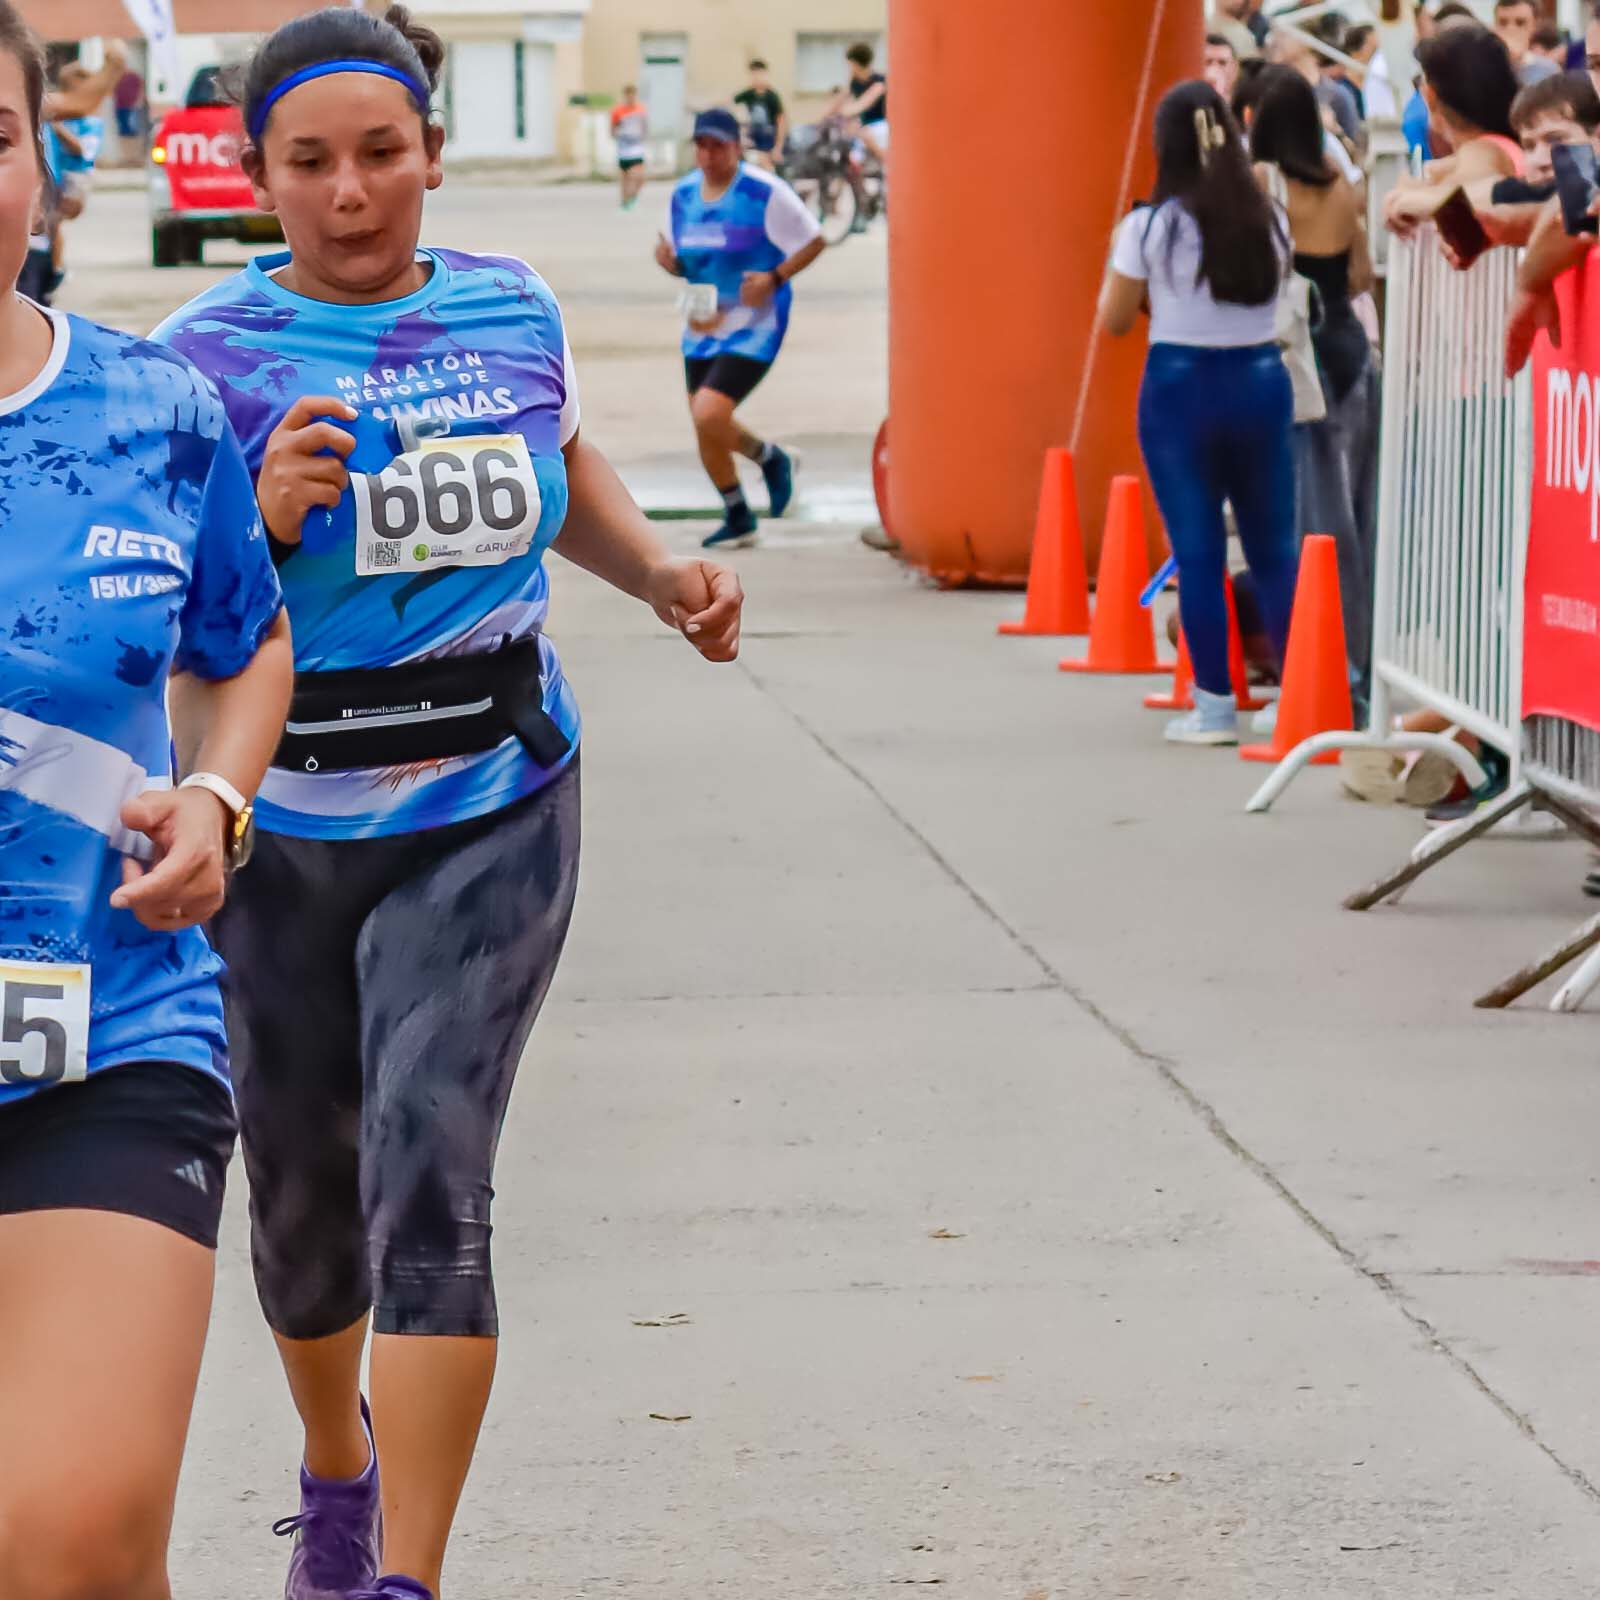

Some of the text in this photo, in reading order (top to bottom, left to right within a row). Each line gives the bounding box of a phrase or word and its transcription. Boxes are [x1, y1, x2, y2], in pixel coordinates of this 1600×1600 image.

[335, 351, 484, 390] MARATÓN
[343, 369, 490, 404] HÉROES DE
[366, 448, 528, 540] 666
[82, 525, 185, 571] RETO
